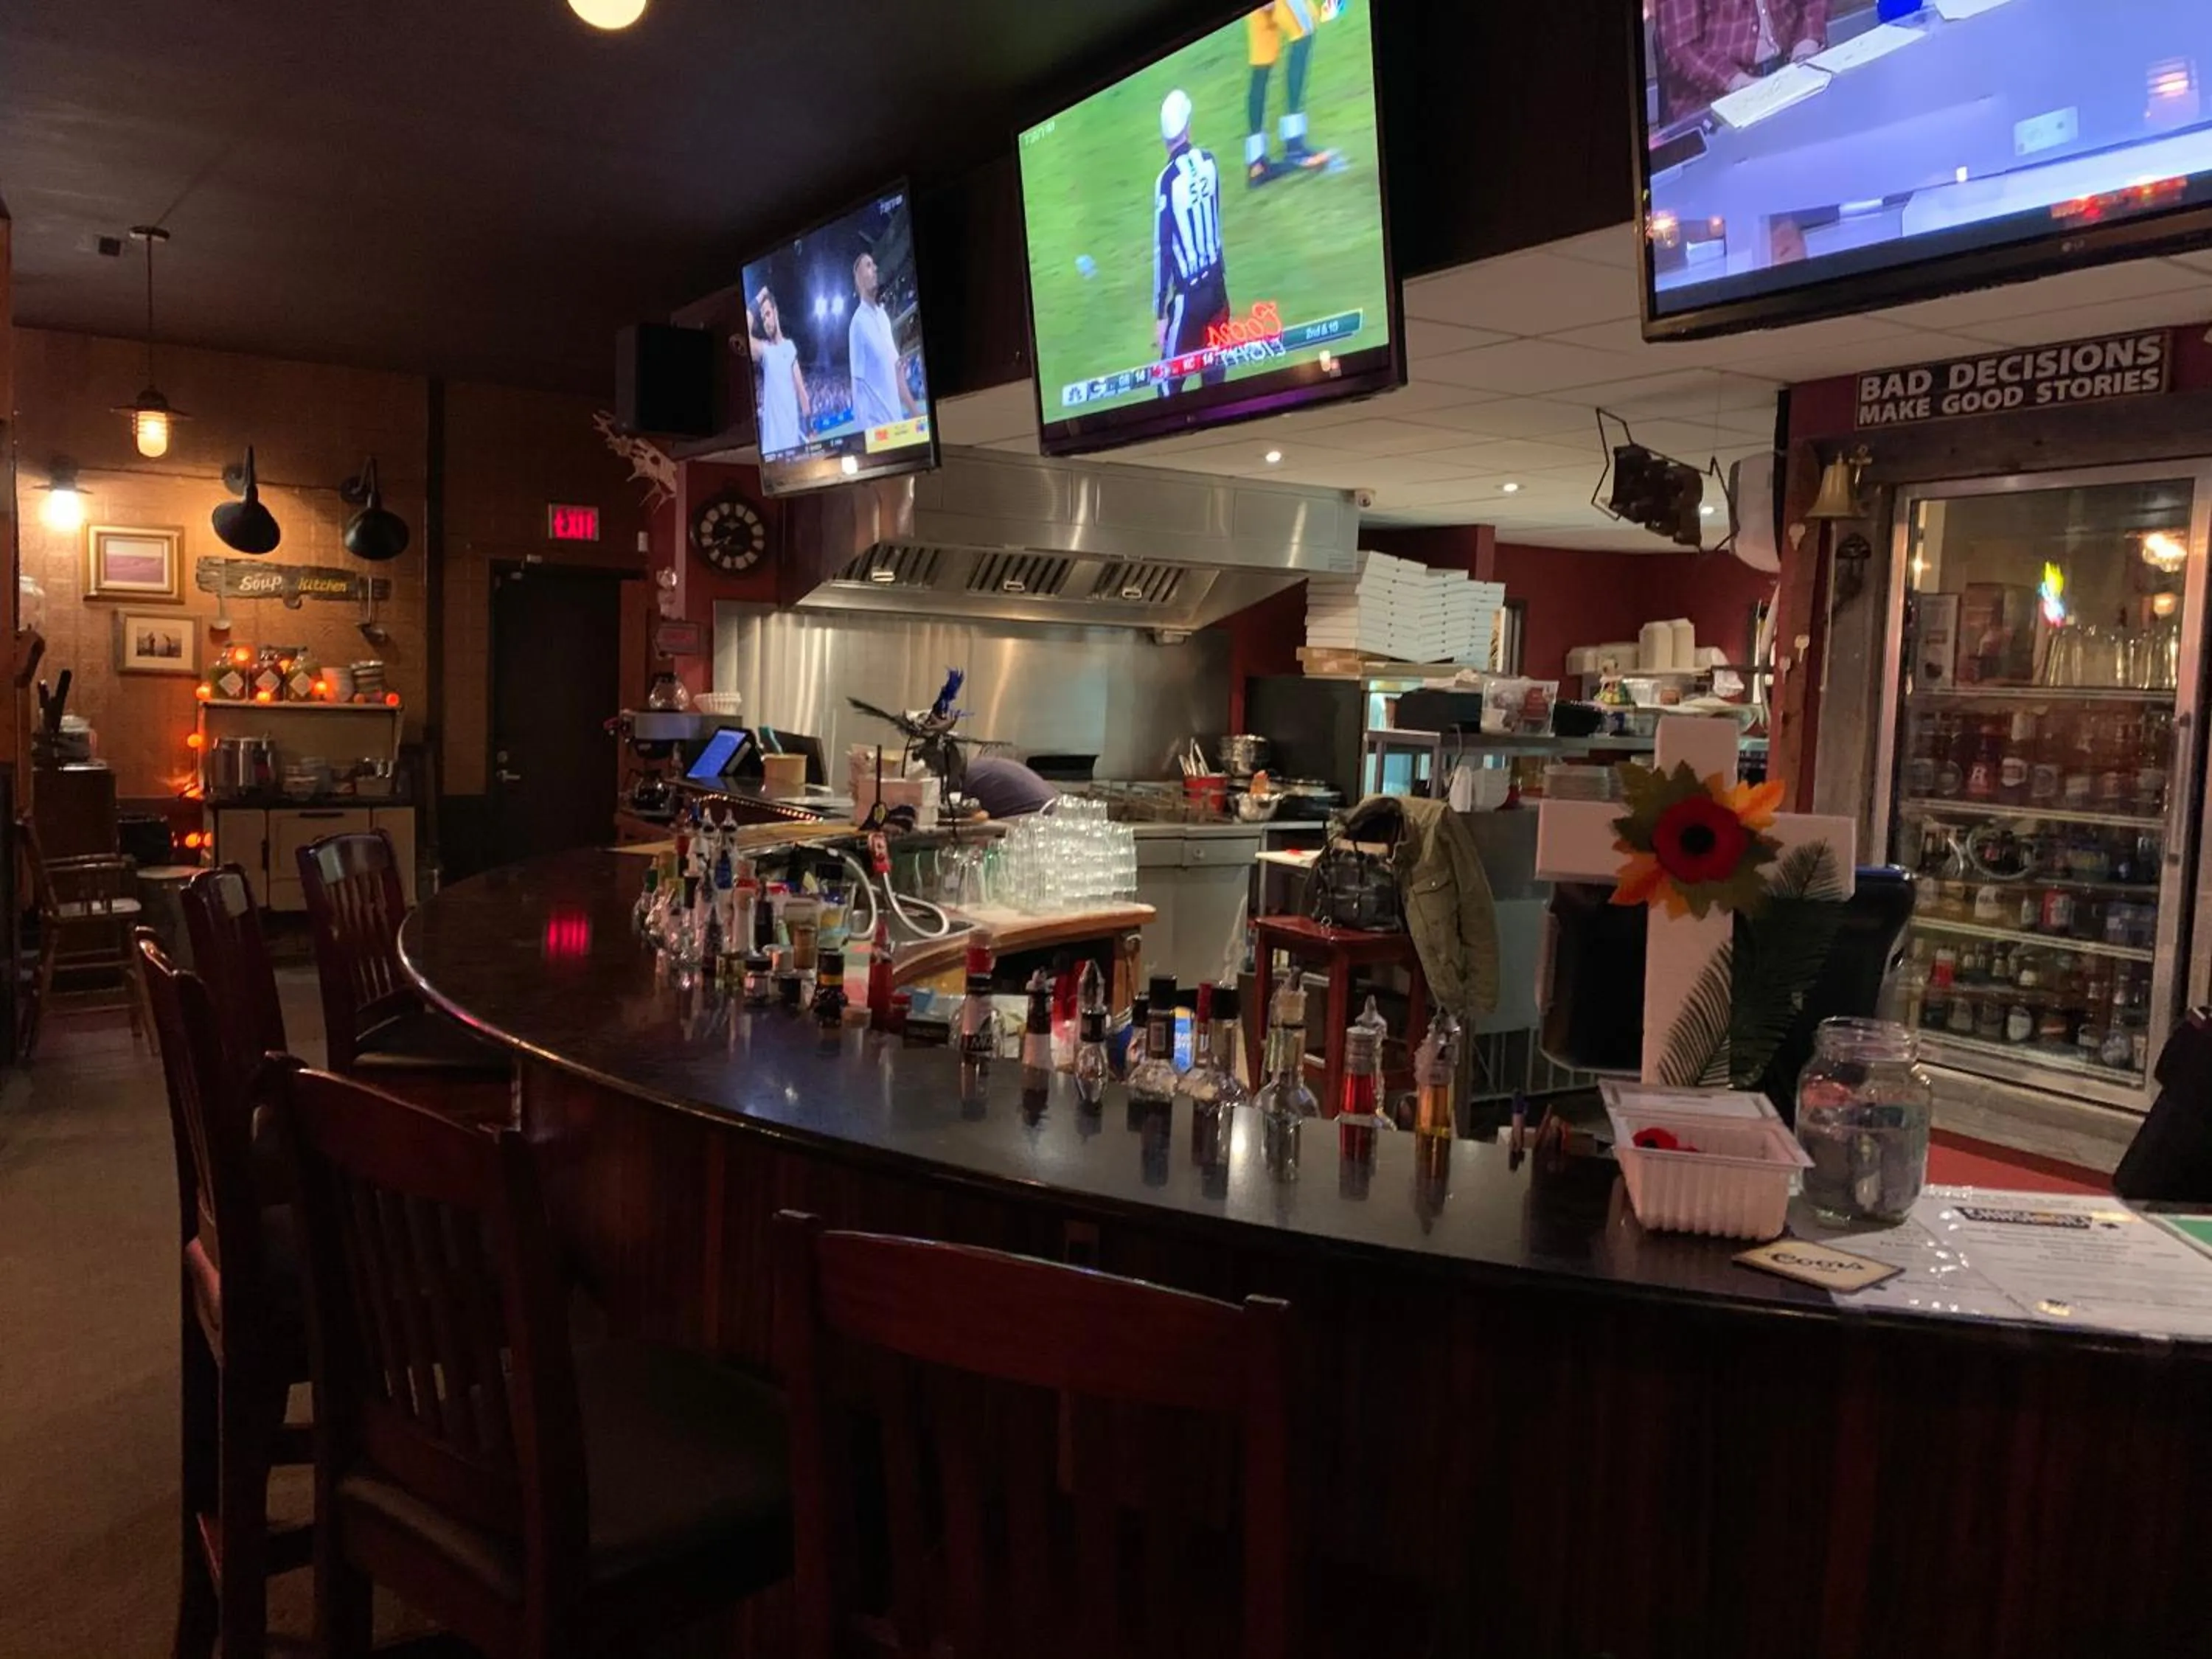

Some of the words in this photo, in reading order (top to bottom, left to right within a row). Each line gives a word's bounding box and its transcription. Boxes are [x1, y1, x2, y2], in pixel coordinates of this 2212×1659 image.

[1859, 397, 1931, 425] MAKE
[1942, 386, 2025, 414] GOOD
[2036, 368, 2160, 403] STORIES
[1860, 370, 1933, 403] BAD
[1948, 334, 2162, 391] DECISIONS
[239, 574, 283, 591] Soup
